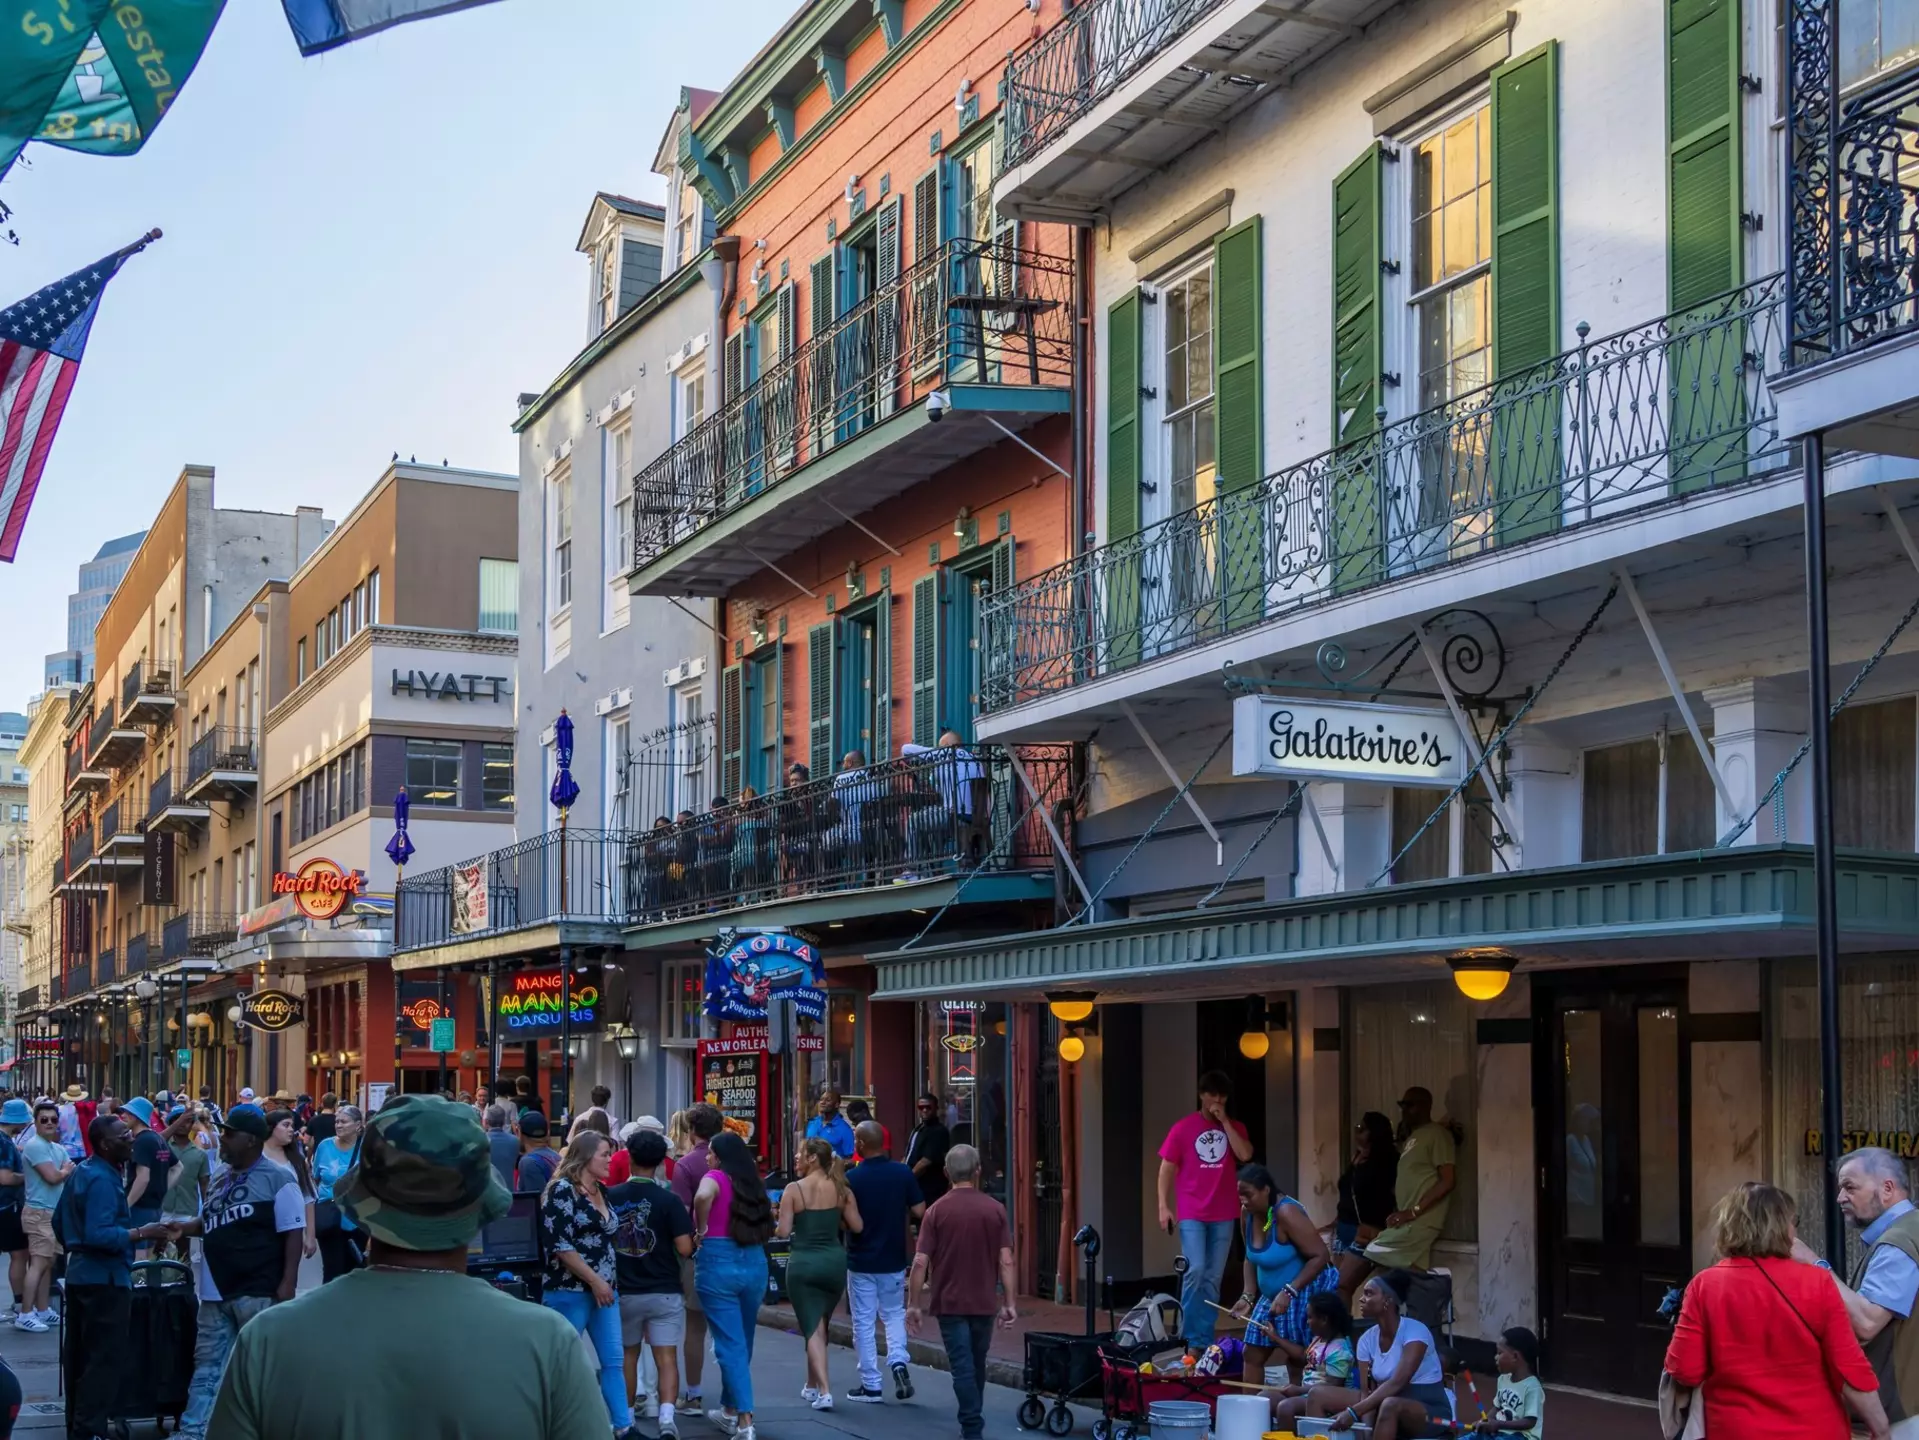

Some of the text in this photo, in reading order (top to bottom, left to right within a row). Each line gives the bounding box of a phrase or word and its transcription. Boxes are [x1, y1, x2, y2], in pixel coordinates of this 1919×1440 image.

[392, 668, 507, 703] HYATT
[1269, 710, 1452, 768] Galatoire's
[155, 856, 163, 900] CENTRIC
[273, 869, 361, 896] Hard Rock
[310, 899, 333, 908] CAFE
[715, 926, 737, 958] Olde
[730, 936, 812, 967] NOLA
[245, 1001, 301, 1016] Hard Rock
[402, 1006, 450, 1017] Hard Rok
[509, 1009, 594, 1027] DAIQURIS
[736, 1027, 768, 1038] AUTHE
[707, 1040, 731, 1053] NEW
[706, 1076, 734, 1090] HIGHEST
[734, 1075, 756, 1087] RATED
[722, 1089, 756, 1099] SEAFOOD
[1209, 1147, 1217, 1159] 1
